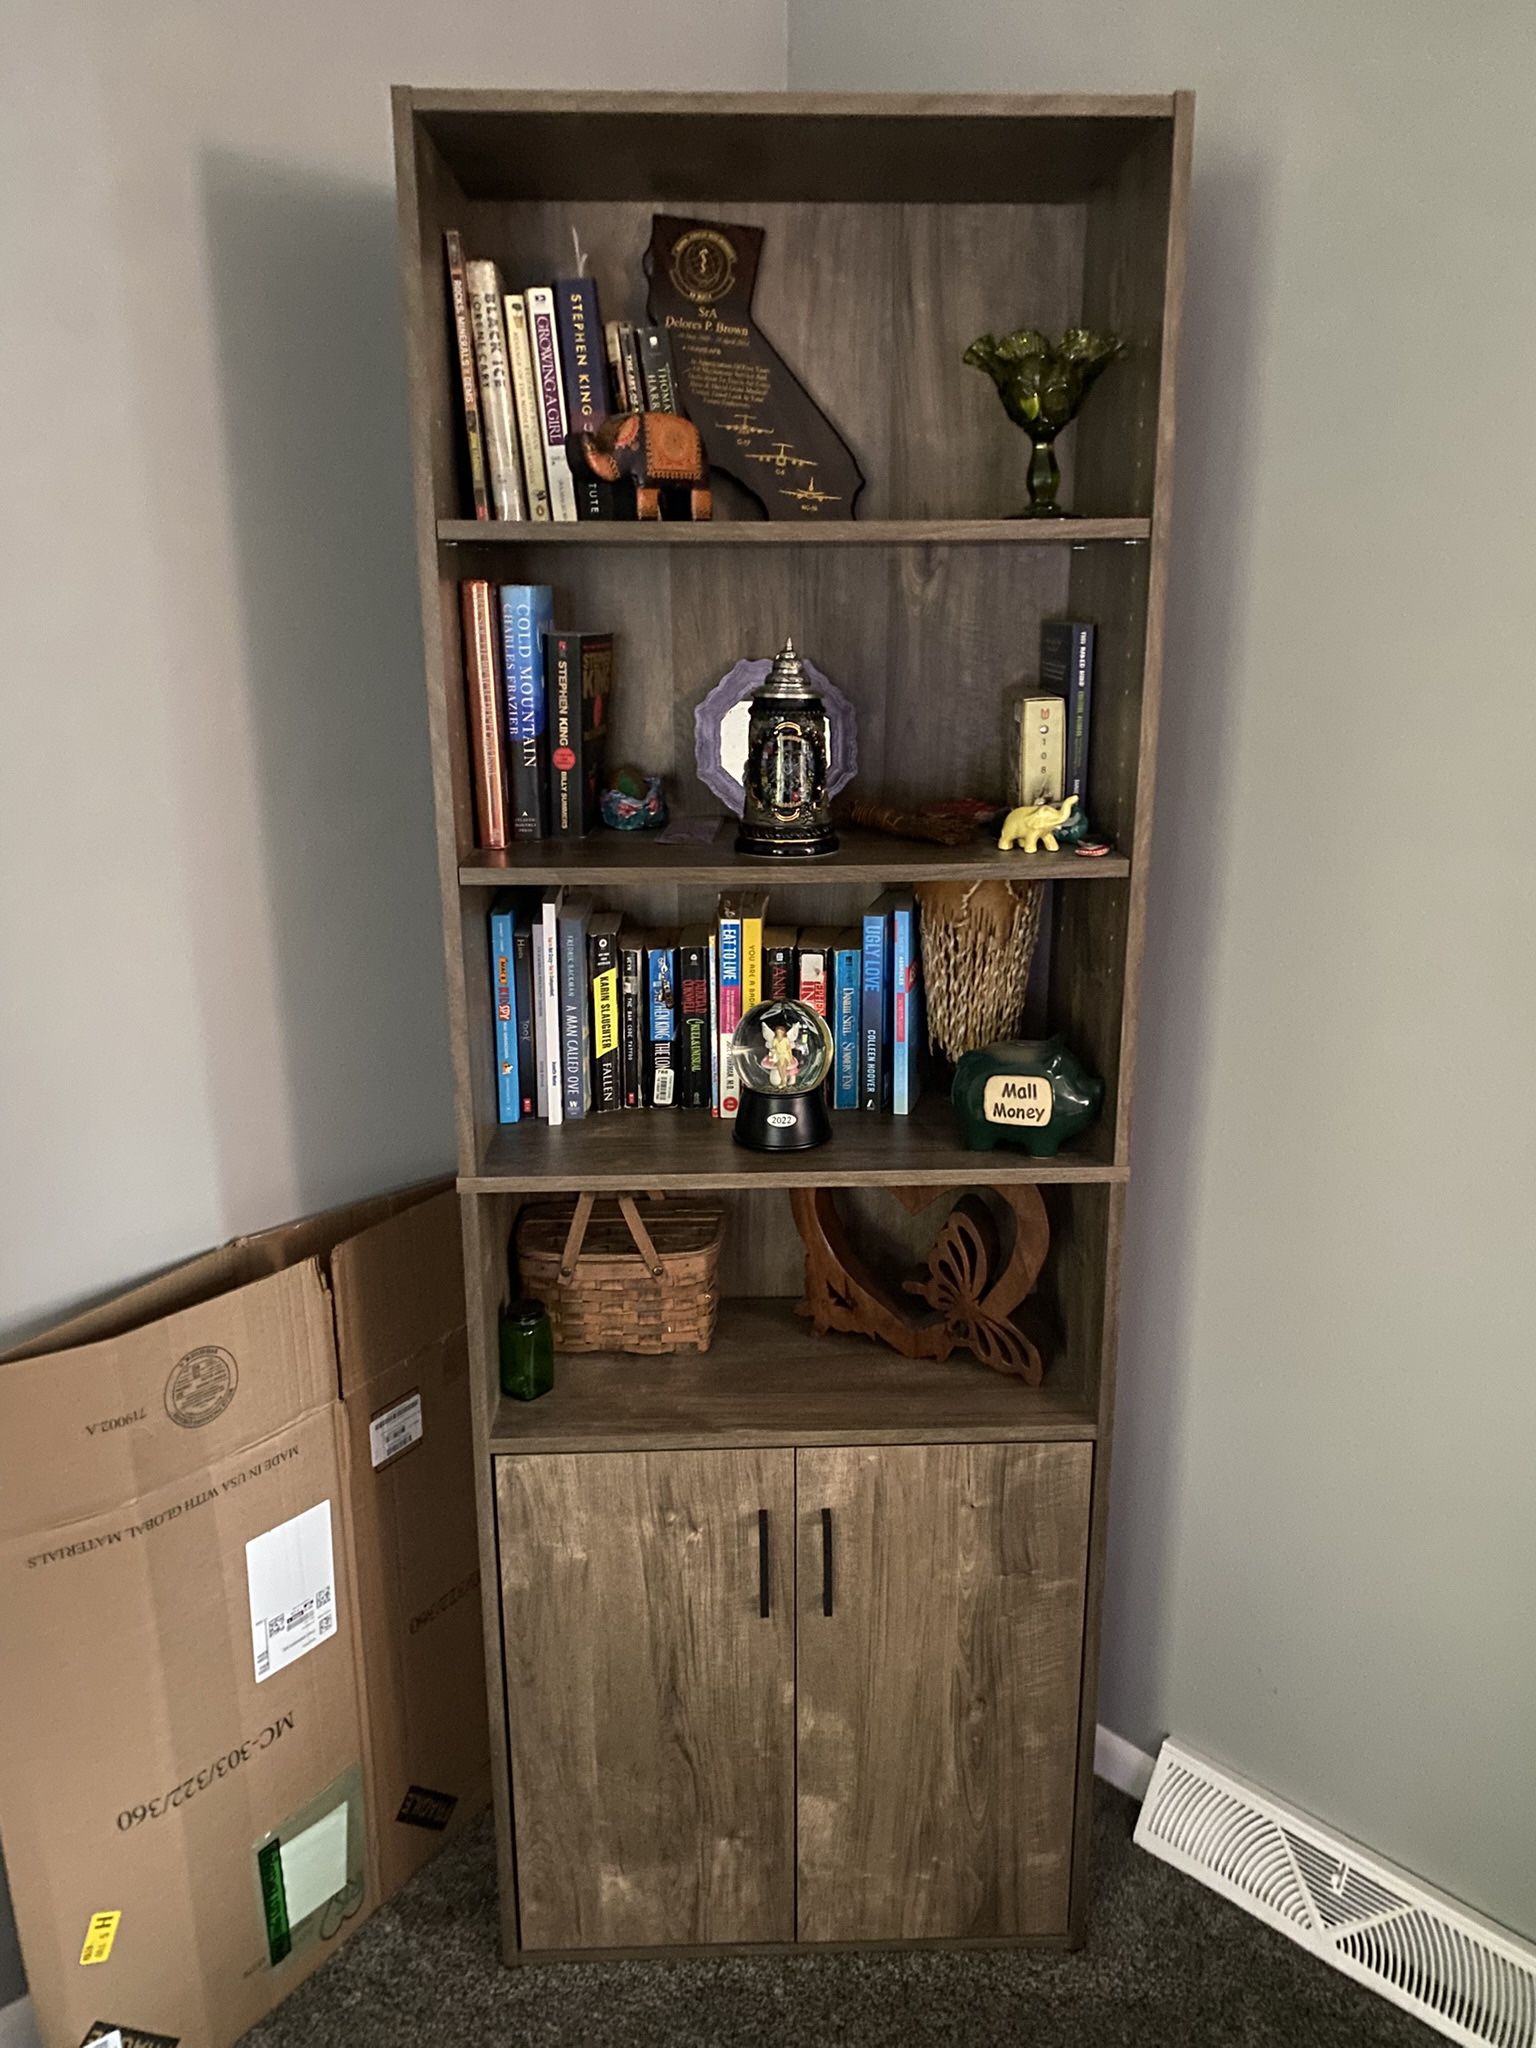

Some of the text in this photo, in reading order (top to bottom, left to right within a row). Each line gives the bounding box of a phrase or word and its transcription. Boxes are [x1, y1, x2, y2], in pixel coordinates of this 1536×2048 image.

[665, 315, 703, 331] Delores
[715, 322, 749, 336] Brown
[699, 306, 718, 319] SrA
[456, 316, 470, 366] MINERALS
[472, 293, 489, 389] LORENE CARY
[485, 293, 505, 388] BLACK ICE
[571, 294, 592, 416] STEPHEN KING
[536, 316, 563, 443] GROWING A GIRL
[627, 374, 635, 391] ART
[503, 604, 519, 735] CHARLES FRAZIER
[516, 604, 536, 768] COLD MOUNTAIN
[558, 661, 568, 714] STEPHEN
[559, 717, 569, 746] KING
[560, 771, 568, 791] BILLY
[723, 929, 737, 945] EAT
[566, 935, 575, 997] FREDRIK BACKMAN
[723, 947, 736, 959] TO
[865, 925, 880, 991] UGLY LOVE
[723, 961, 737, 980] LIVE
[773, 967, 787, 999] ANN
[802, 985, 815, 1002] IN
[815, 984, 825, 1016] EPHEN
[498, 1004, 510, 1019] SPY
[566, 1015, 577, 1036] MAN
[599, 976, 612, 1049] KARIN SLAUGHTER
[654, 1021, 670, 1038] KING
[566, 1040, 578, 1073] CALLED
[654, 1042, 670, 1055] THE
[866, 1029, 876, 1092] COLLEEN HOOVER
[567, 1077, 579, 1094] OVE
[602, 1063, 613, 1101] FALLEN
[1002, 1083, 1038, 1100] Mall
[771, 1115, 793, 1125] 2022
[993, 1103, 1046, 1122] Money
[26, 1444, 300, 1569] MADE IN USA WITH GLOBAL MATERIALS
[116, 1711, 296, 1832] MC-303/322/360
[95, 1916, 113, 1930] H
